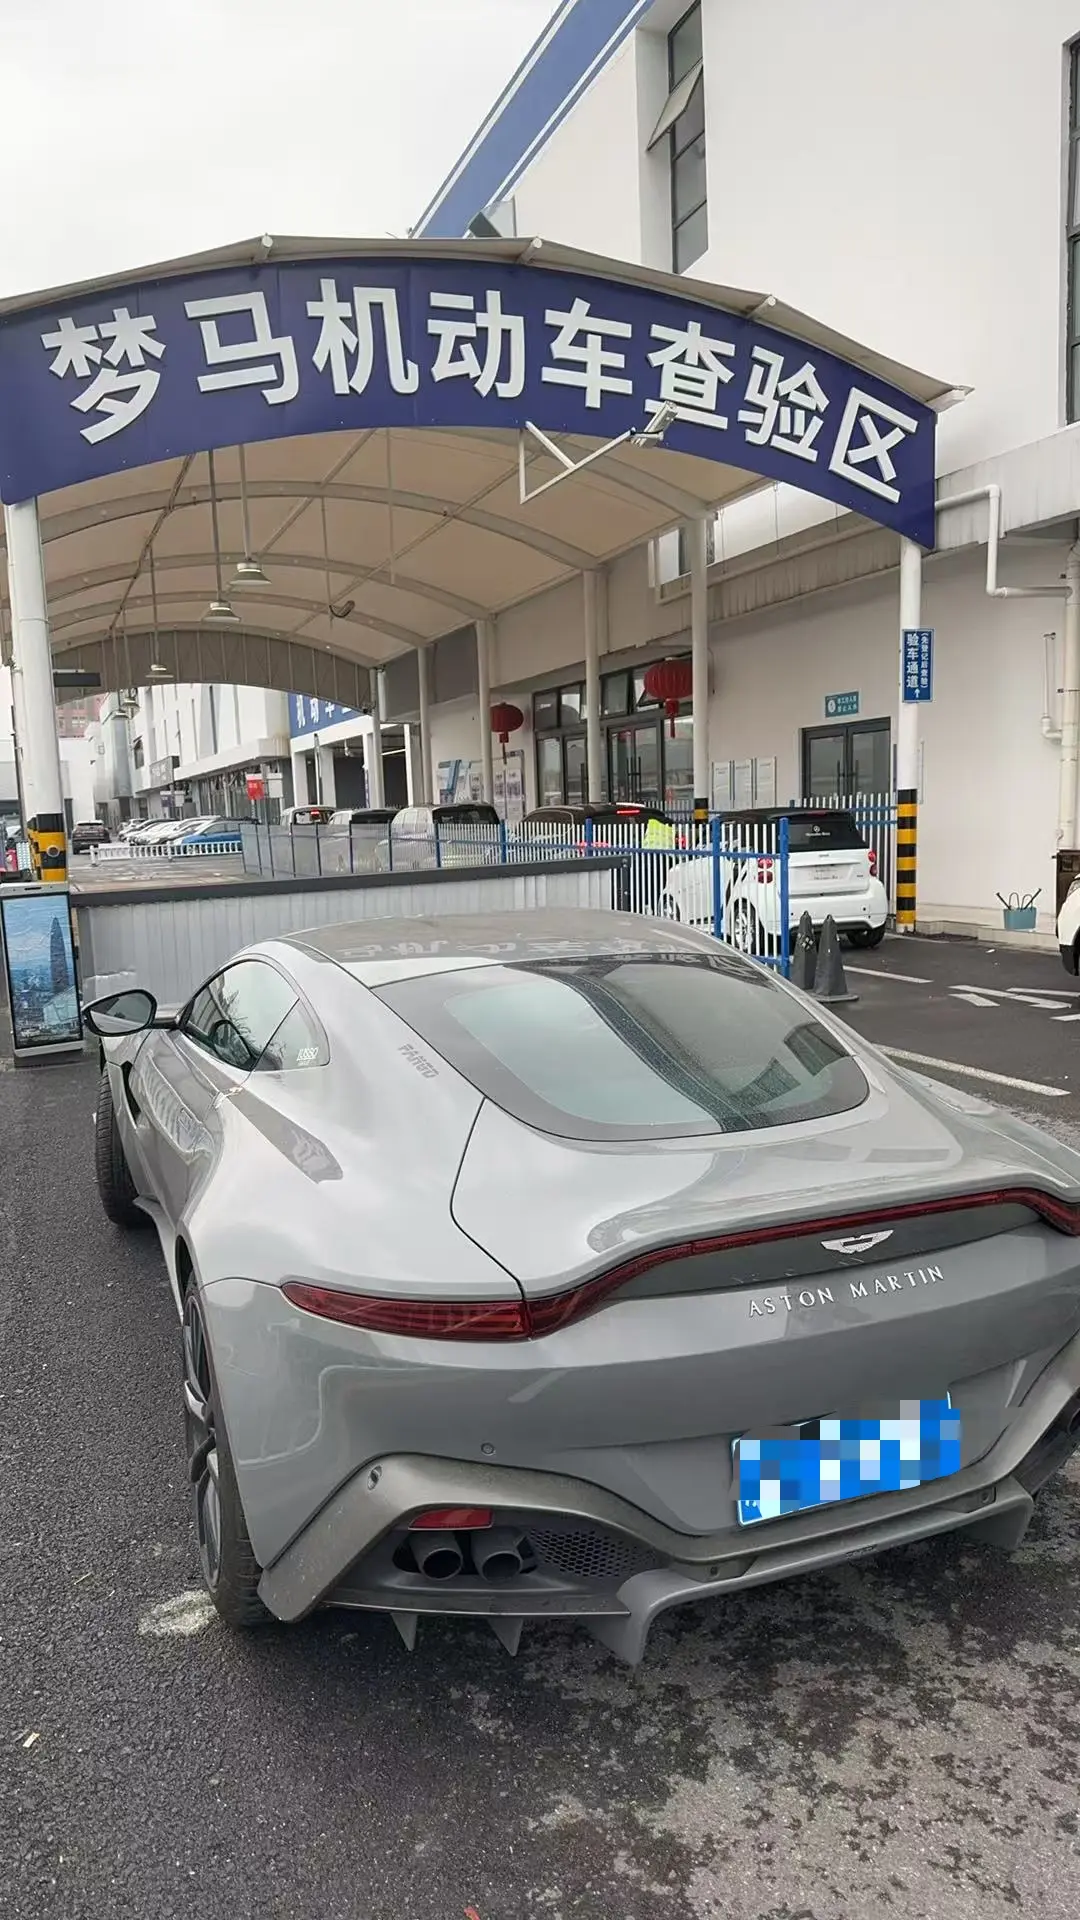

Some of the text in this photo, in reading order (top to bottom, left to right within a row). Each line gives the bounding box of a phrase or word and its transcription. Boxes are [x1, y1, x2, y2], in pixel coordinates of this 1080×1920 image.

[41, 279, 918, 503] 梦马机动车查验区
[906, 633, 919, 688] 验车通道
[749, 1266, 944, 1317] ASTON MARTIN
